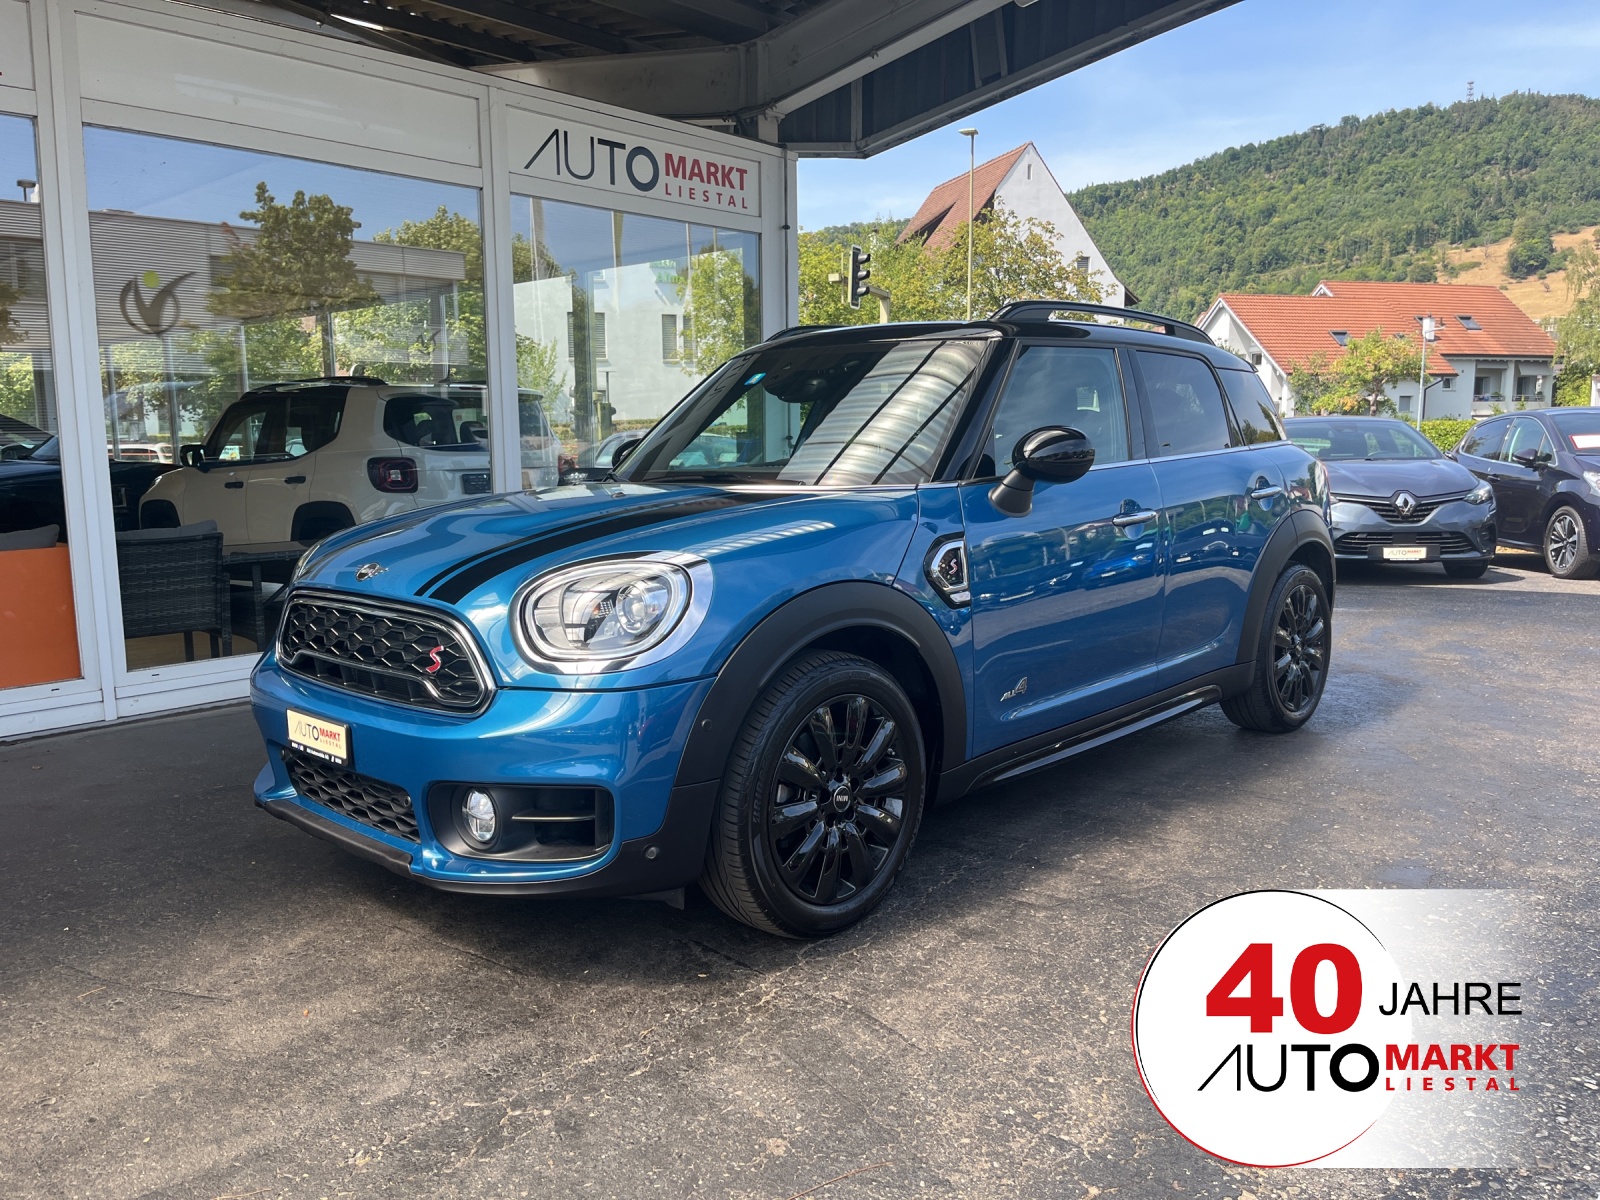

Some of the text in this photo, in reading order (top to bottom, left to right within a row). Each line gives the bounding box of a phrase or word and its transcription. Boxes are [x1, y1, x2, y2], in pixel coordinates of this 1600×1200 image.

[523, 128, 748, 193] AUTO MARKT
[664, 183, 748, 210] LIESTAL
[425, 645, 444, 674] S
[294, 720, 341, 742] AUTO MARKT
